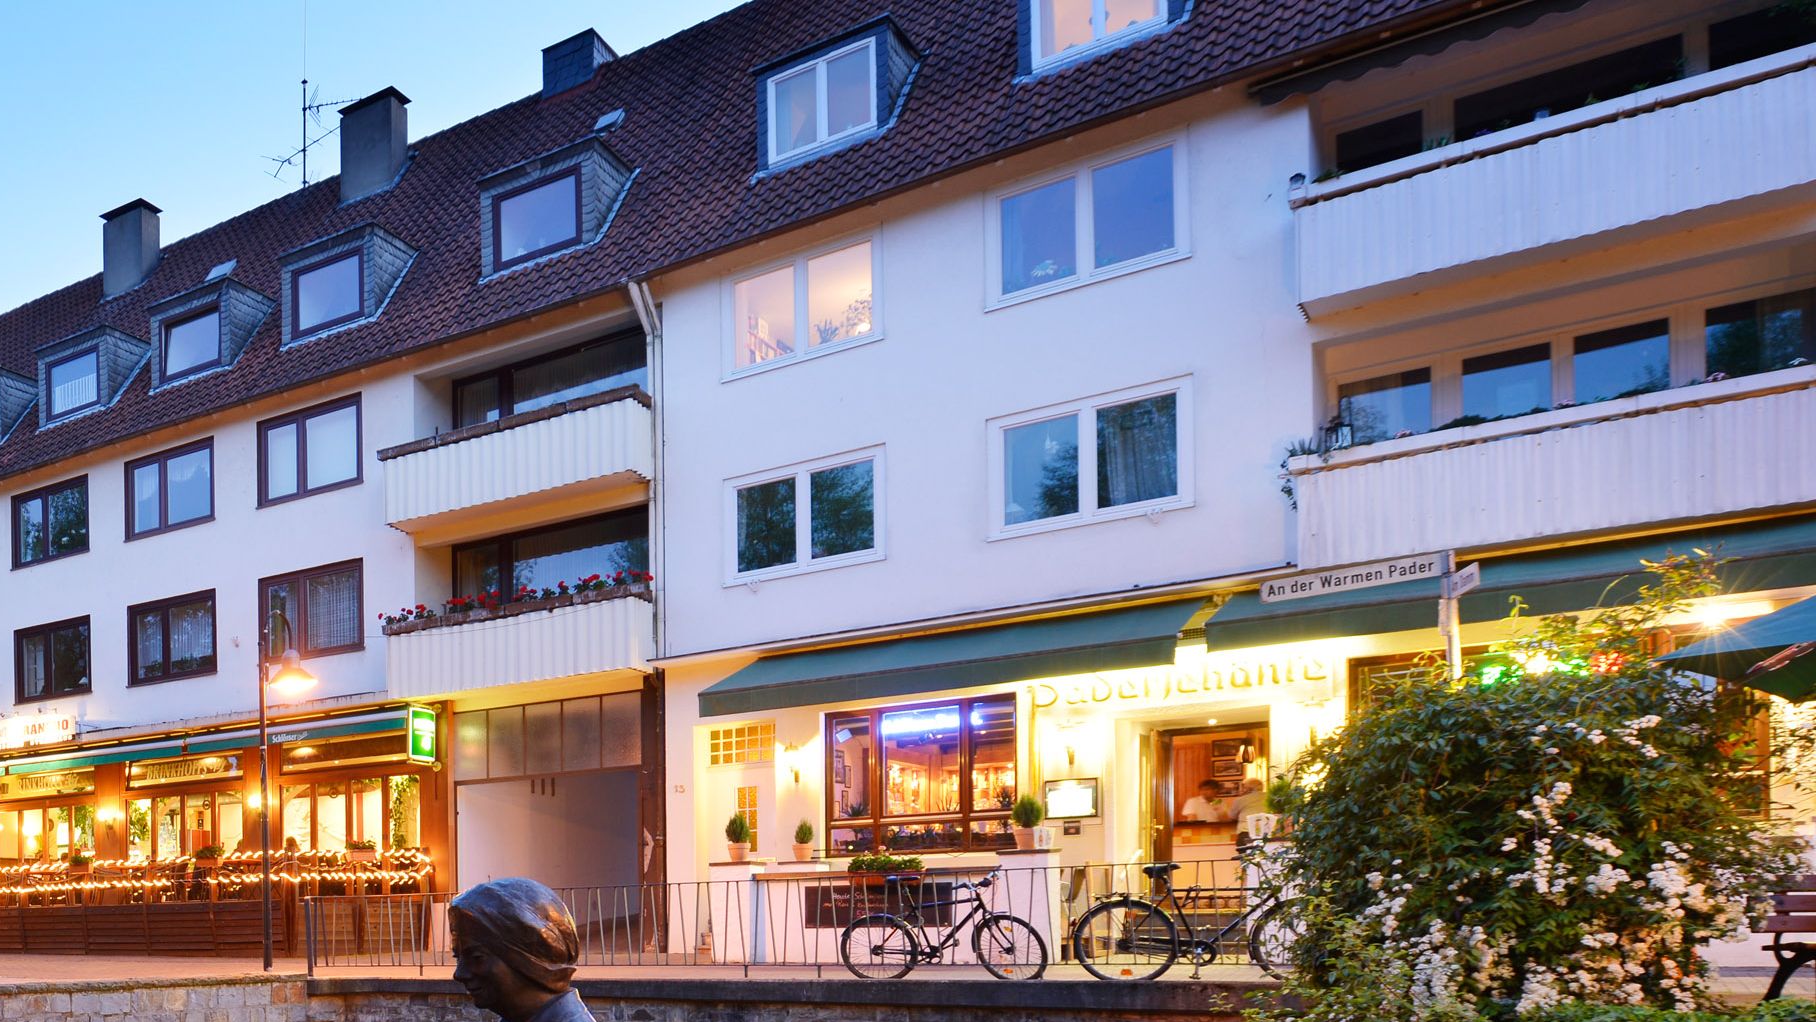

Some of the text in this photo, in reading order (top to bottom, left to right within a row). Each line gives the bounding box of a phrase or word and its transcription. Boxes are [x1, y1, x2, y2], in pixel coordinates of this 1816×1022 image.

[1267, 561, 1434, 598] An der Warmen Pader
